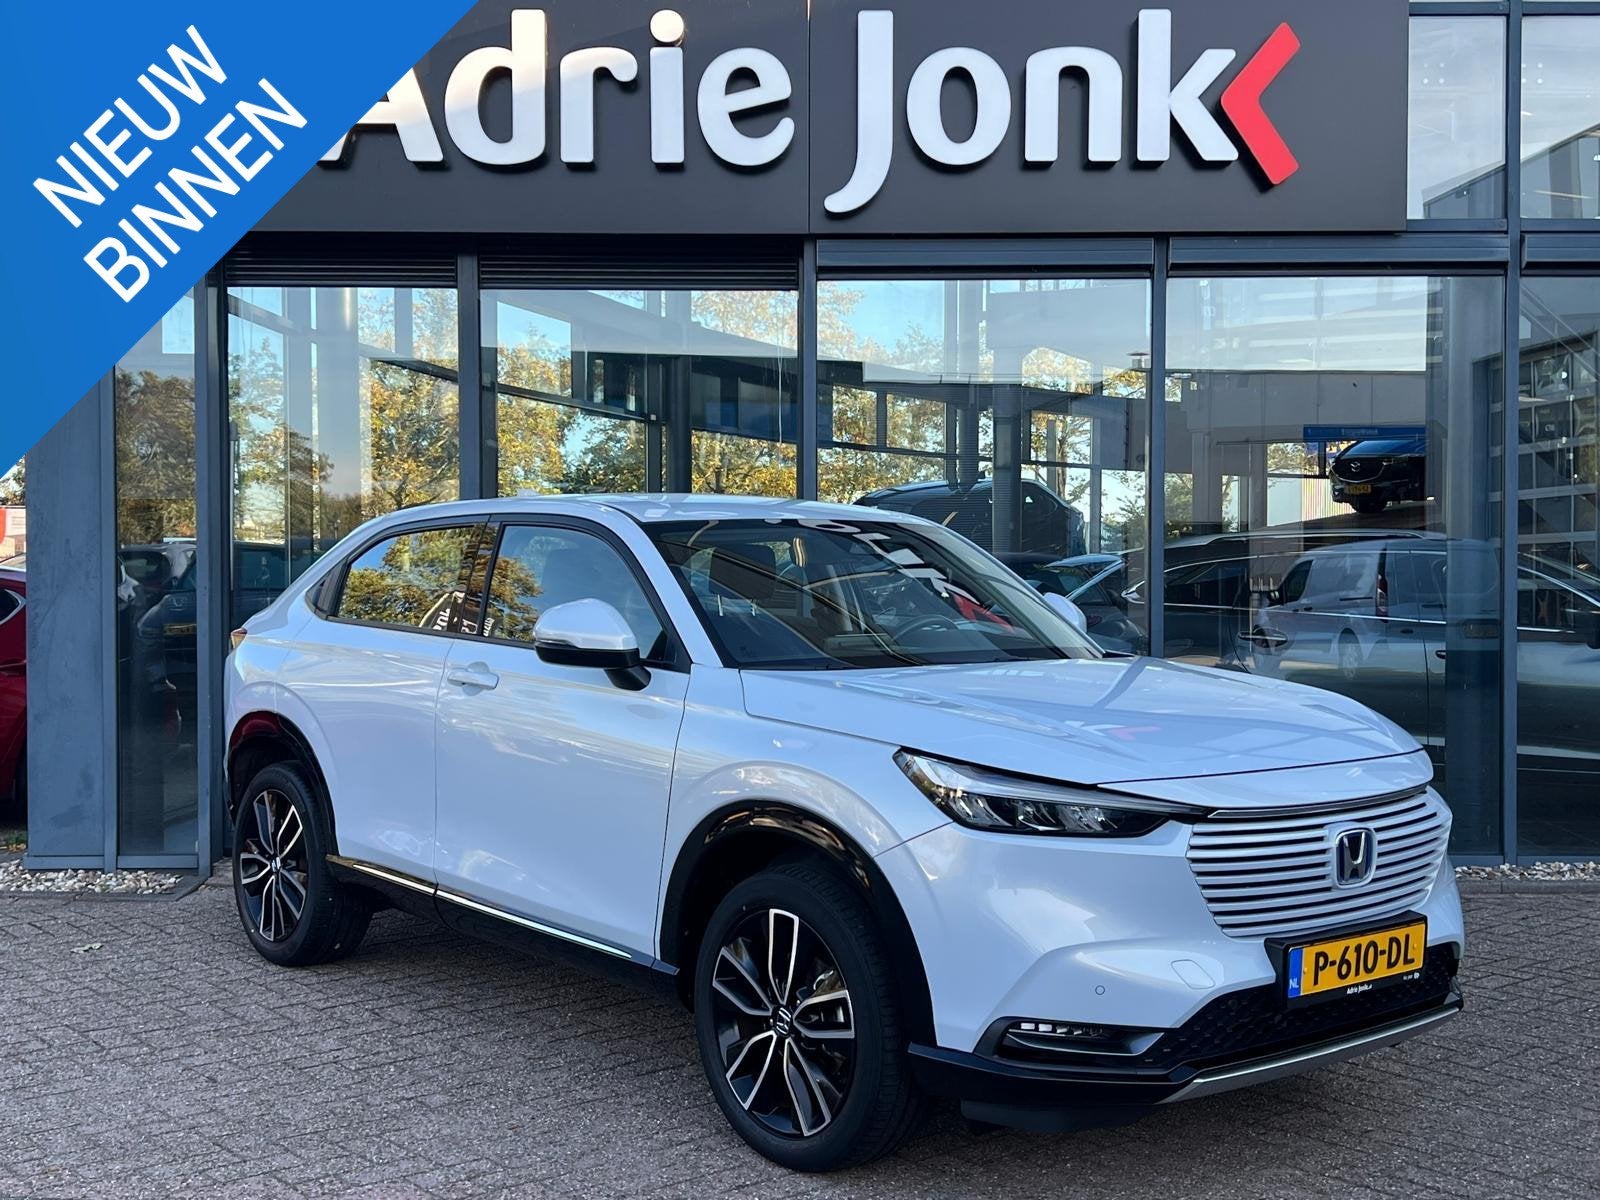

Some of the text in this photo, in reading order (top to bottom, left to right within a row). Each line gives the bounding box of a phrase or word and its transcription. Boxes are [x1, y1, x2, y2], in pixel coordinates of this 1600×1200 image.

[823, 8, 1239, 213] Jonk
[1289, 978, 1299, 990] NL
[1313, 933, 1415, 987] P-610-DL
